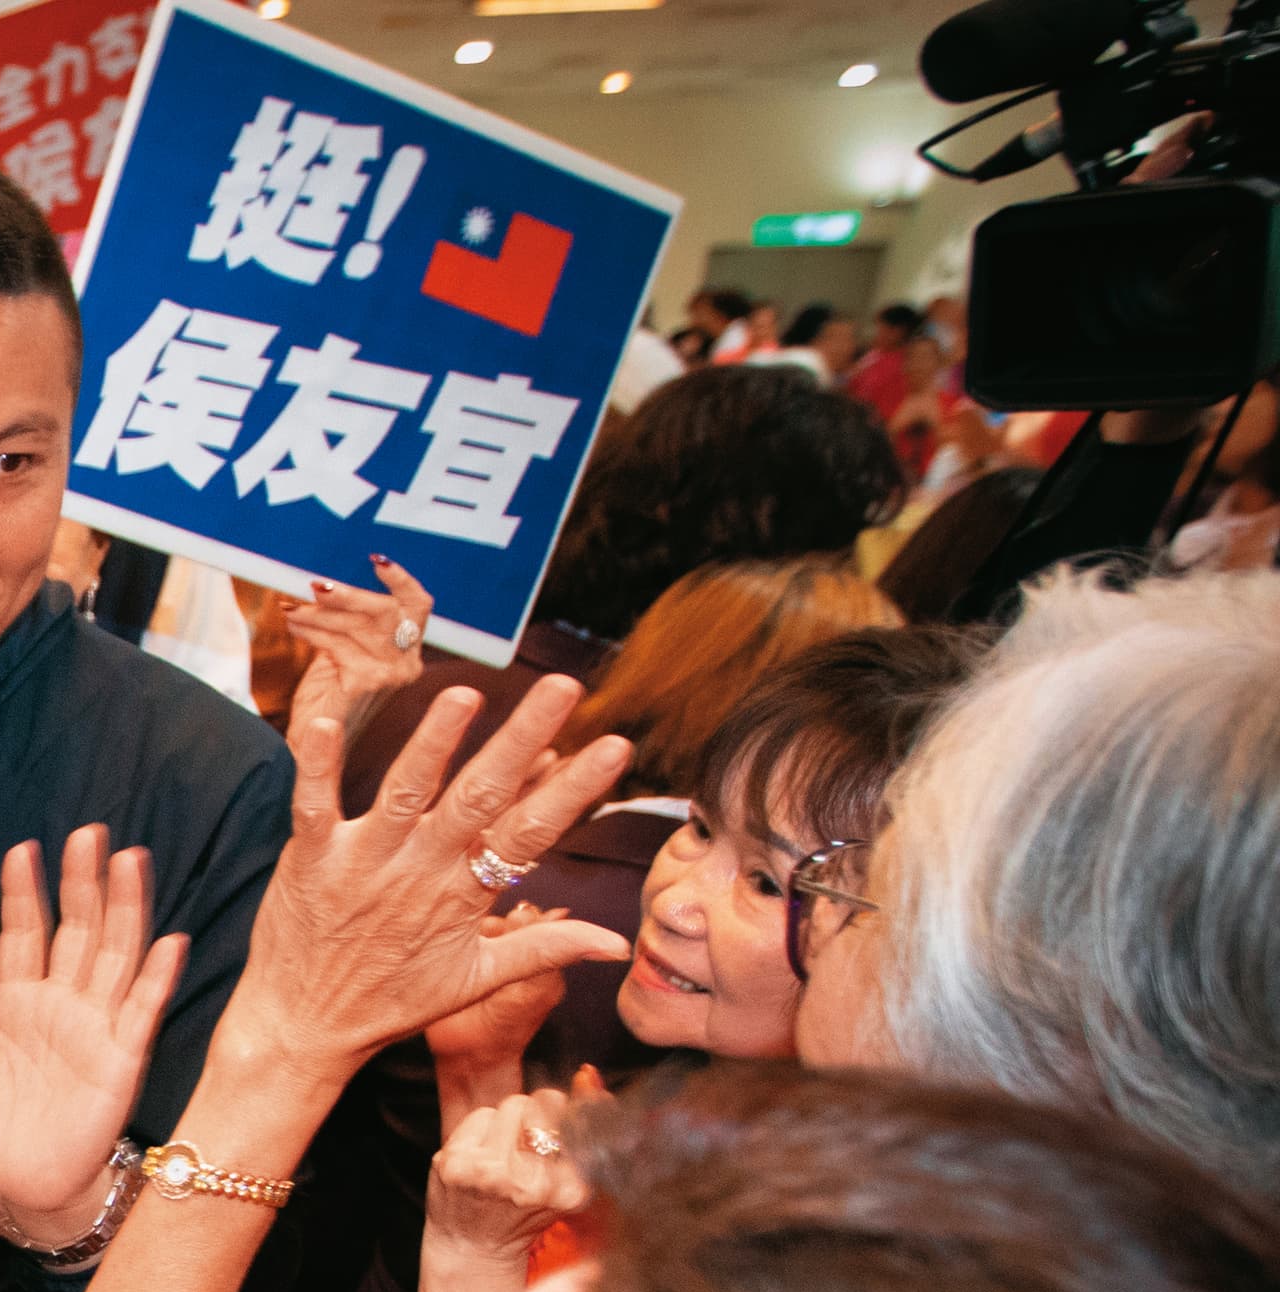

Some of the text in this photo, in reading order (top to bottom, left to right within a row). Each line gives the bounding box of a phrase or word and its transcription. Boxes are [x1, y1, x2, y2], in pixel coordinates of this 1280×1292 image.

[191, 97, 424, 282] 挺!
[76, 299, 578, 547] 侯友宜
